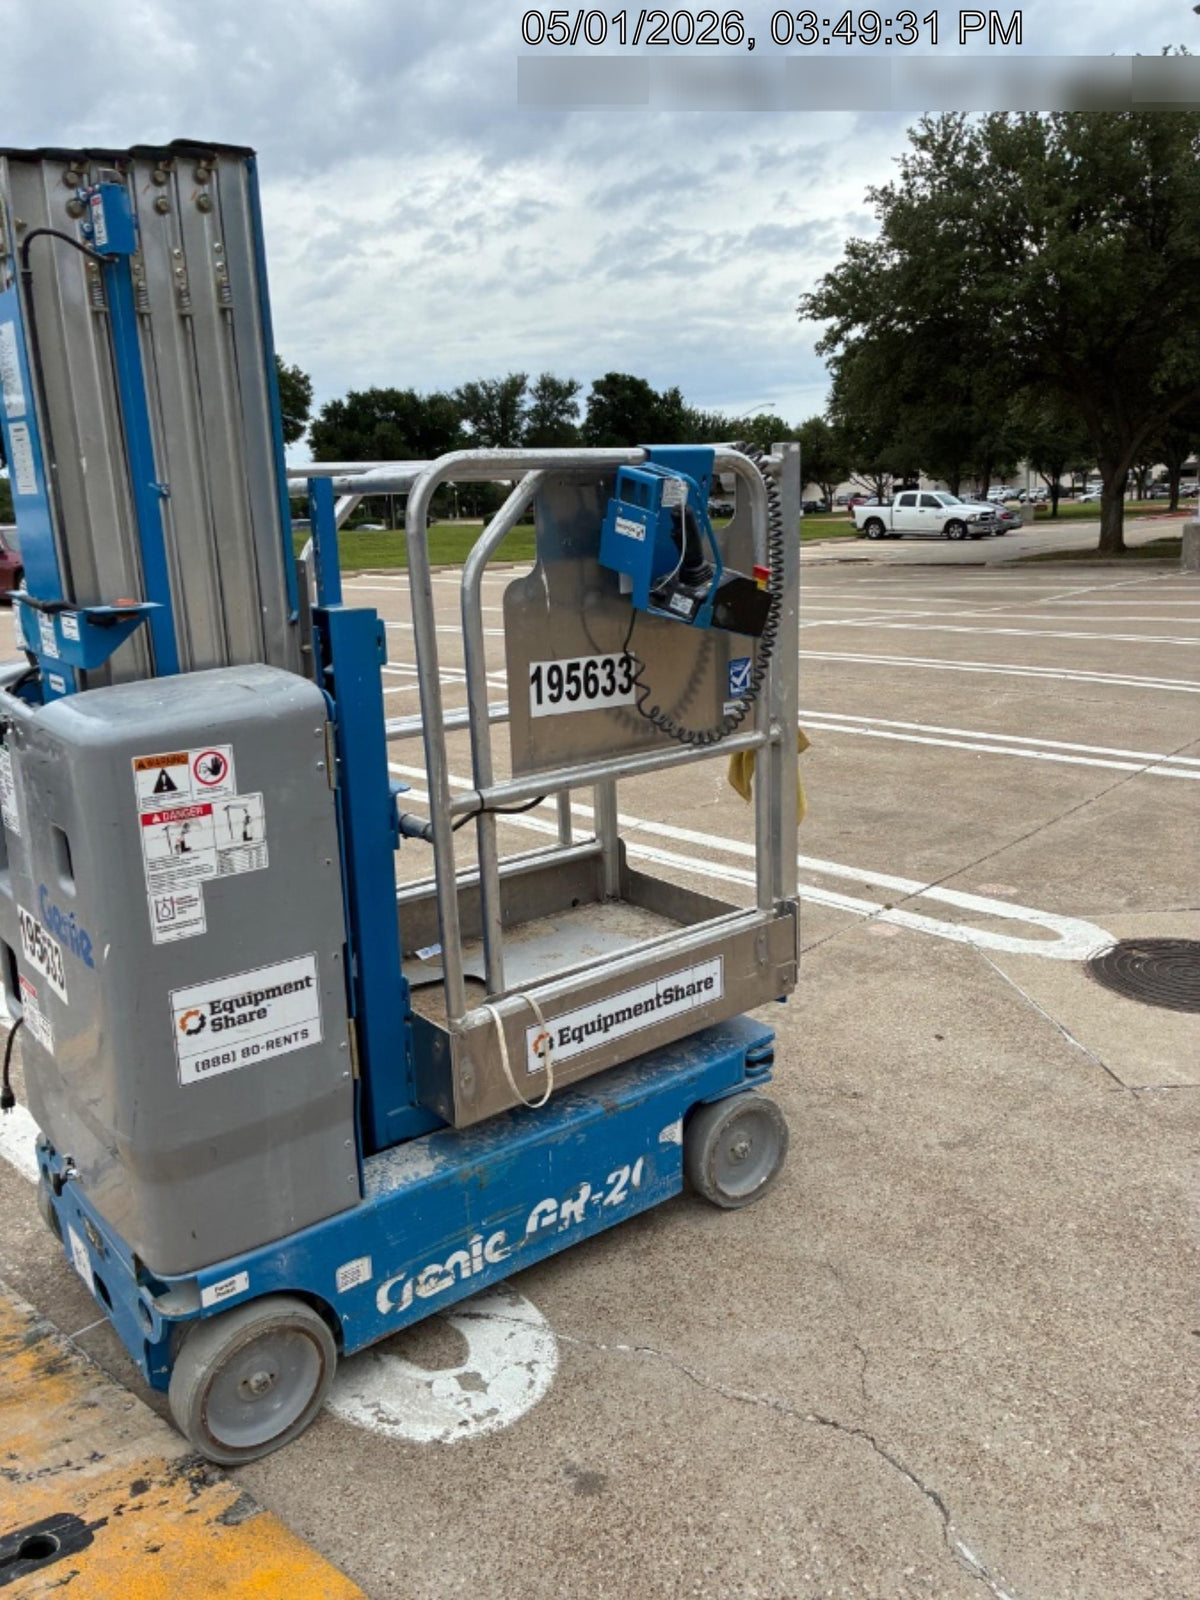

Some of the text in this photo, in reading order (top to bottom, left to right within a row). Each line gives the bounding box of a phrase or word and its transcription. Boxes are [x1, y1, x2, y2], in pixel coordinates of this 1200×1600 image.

[531, 656, 633, 705] 195633
[162, 806, 204, 822] DANGER
[209, 975, 313, 1016] Equipment
[557, 976, 714, 1046] EquipmentShare
[210, 1007, 267, 1033] Share
[195, 1051, 236, 1073] (888)
